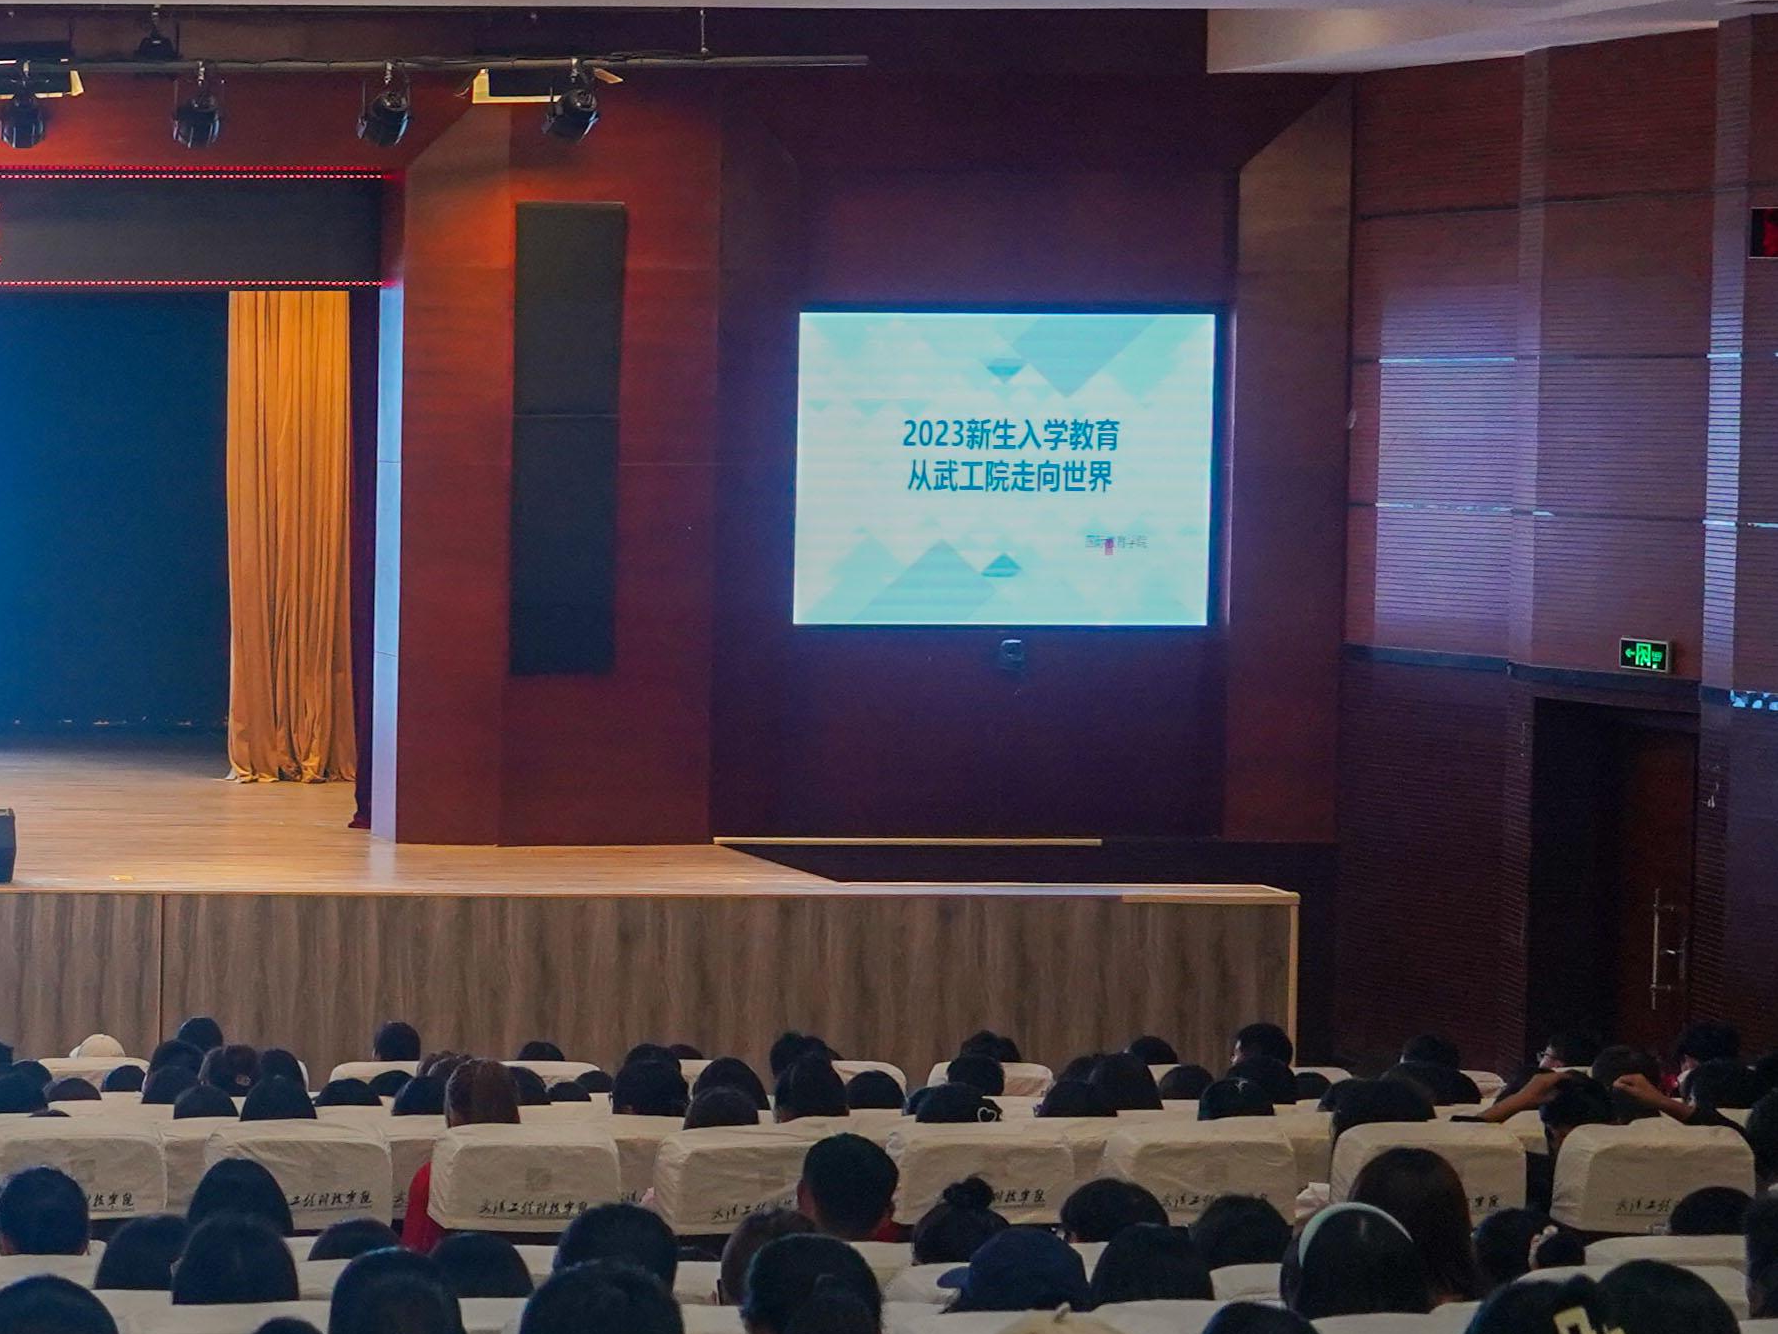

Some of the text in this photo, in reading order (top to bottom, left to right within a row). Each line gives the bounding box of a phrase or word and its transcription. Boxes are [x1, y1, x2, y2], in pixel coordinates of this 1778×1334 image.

[902, 418, 1120, 451] 2023新生入学教育
[907, 459, 1113, 493] 从武工院走向世界
